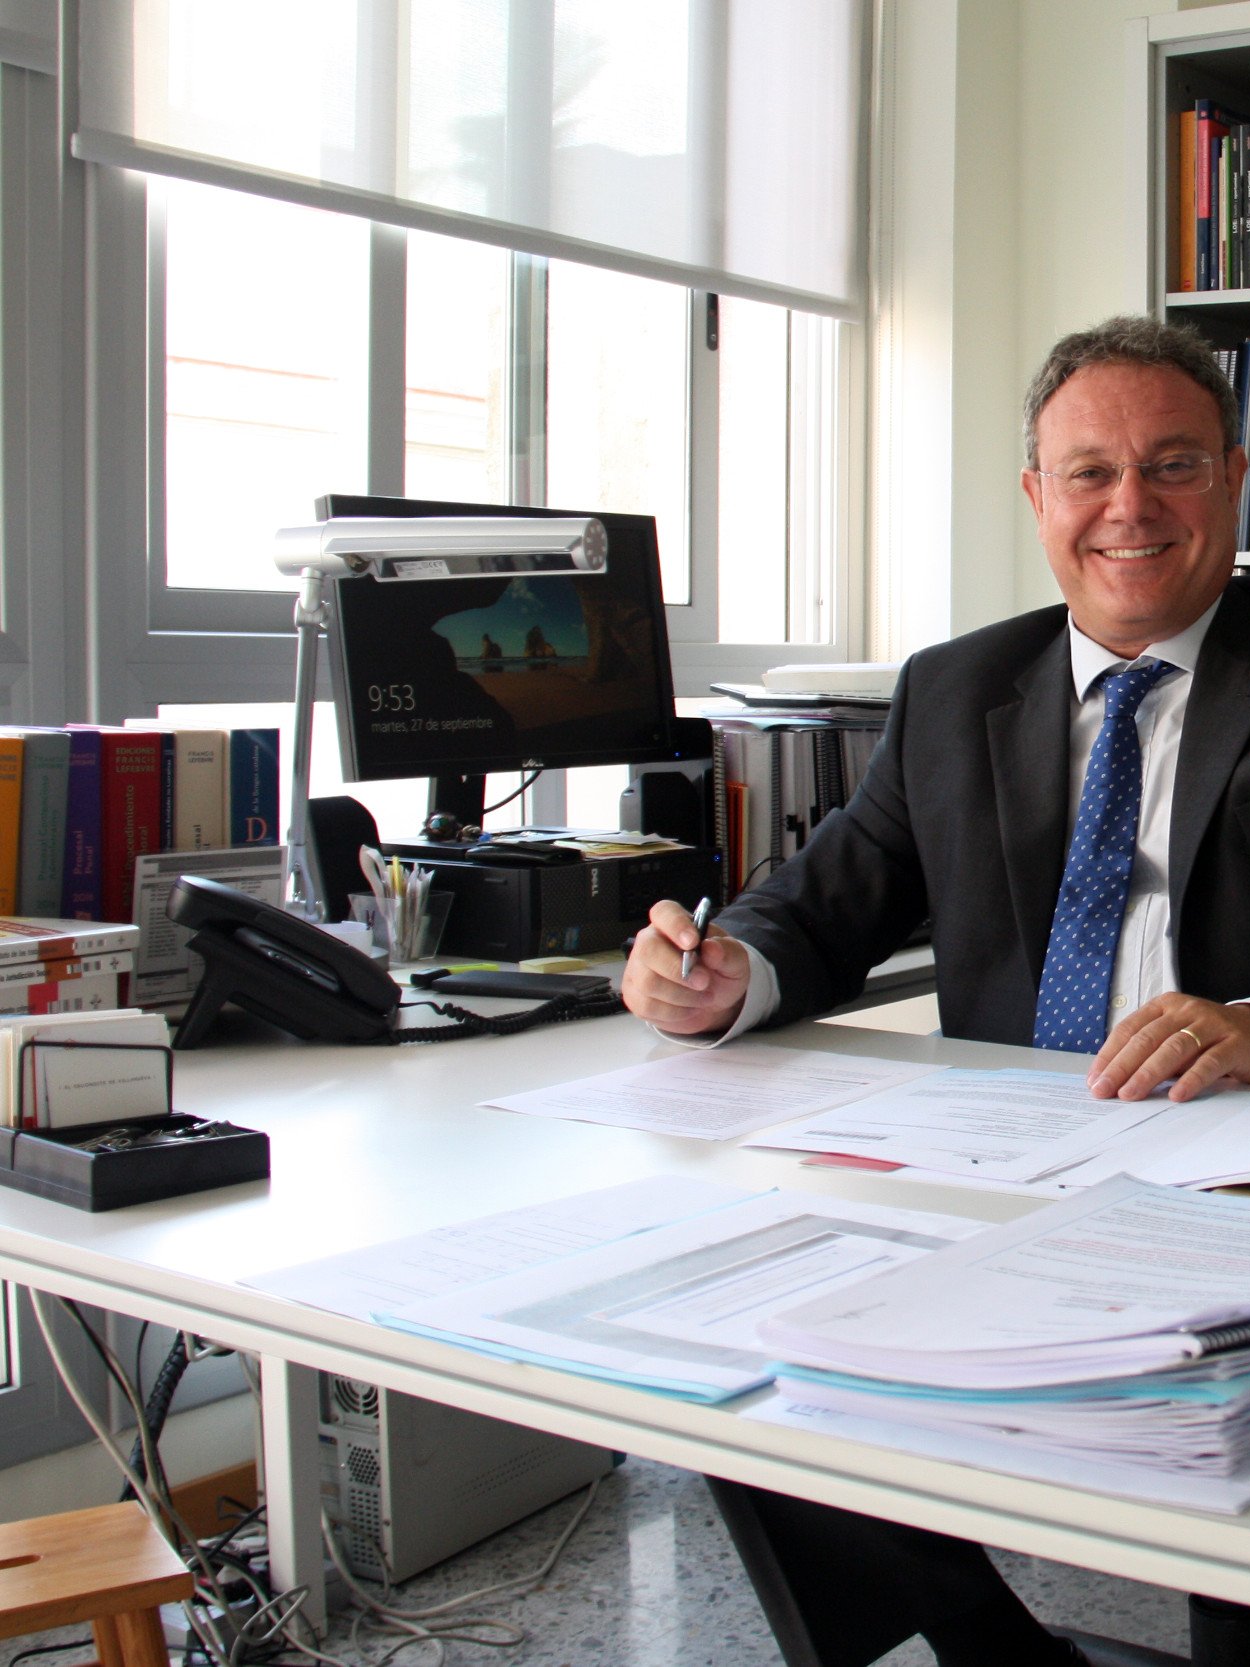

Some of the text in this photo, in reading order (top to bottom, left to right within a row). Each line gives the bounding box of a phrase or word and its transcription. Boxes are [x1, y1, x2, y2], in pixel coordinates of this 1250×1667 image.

[368, 685, 416, 711] 9:53
[371, 717, 493, 733] martes, 27 de septiembre
[116, 747, 156, 755] EDICIONES
[116, 756, 157, 764] FRANCIS
[115, 764, 156, 773] LEFEBVRE
[245, 817, 268, 842] D
[74, 830, 83, 875] Procesal
[85, 845, 94, 873] Penal
[591, 868, 599, 897] DELL
